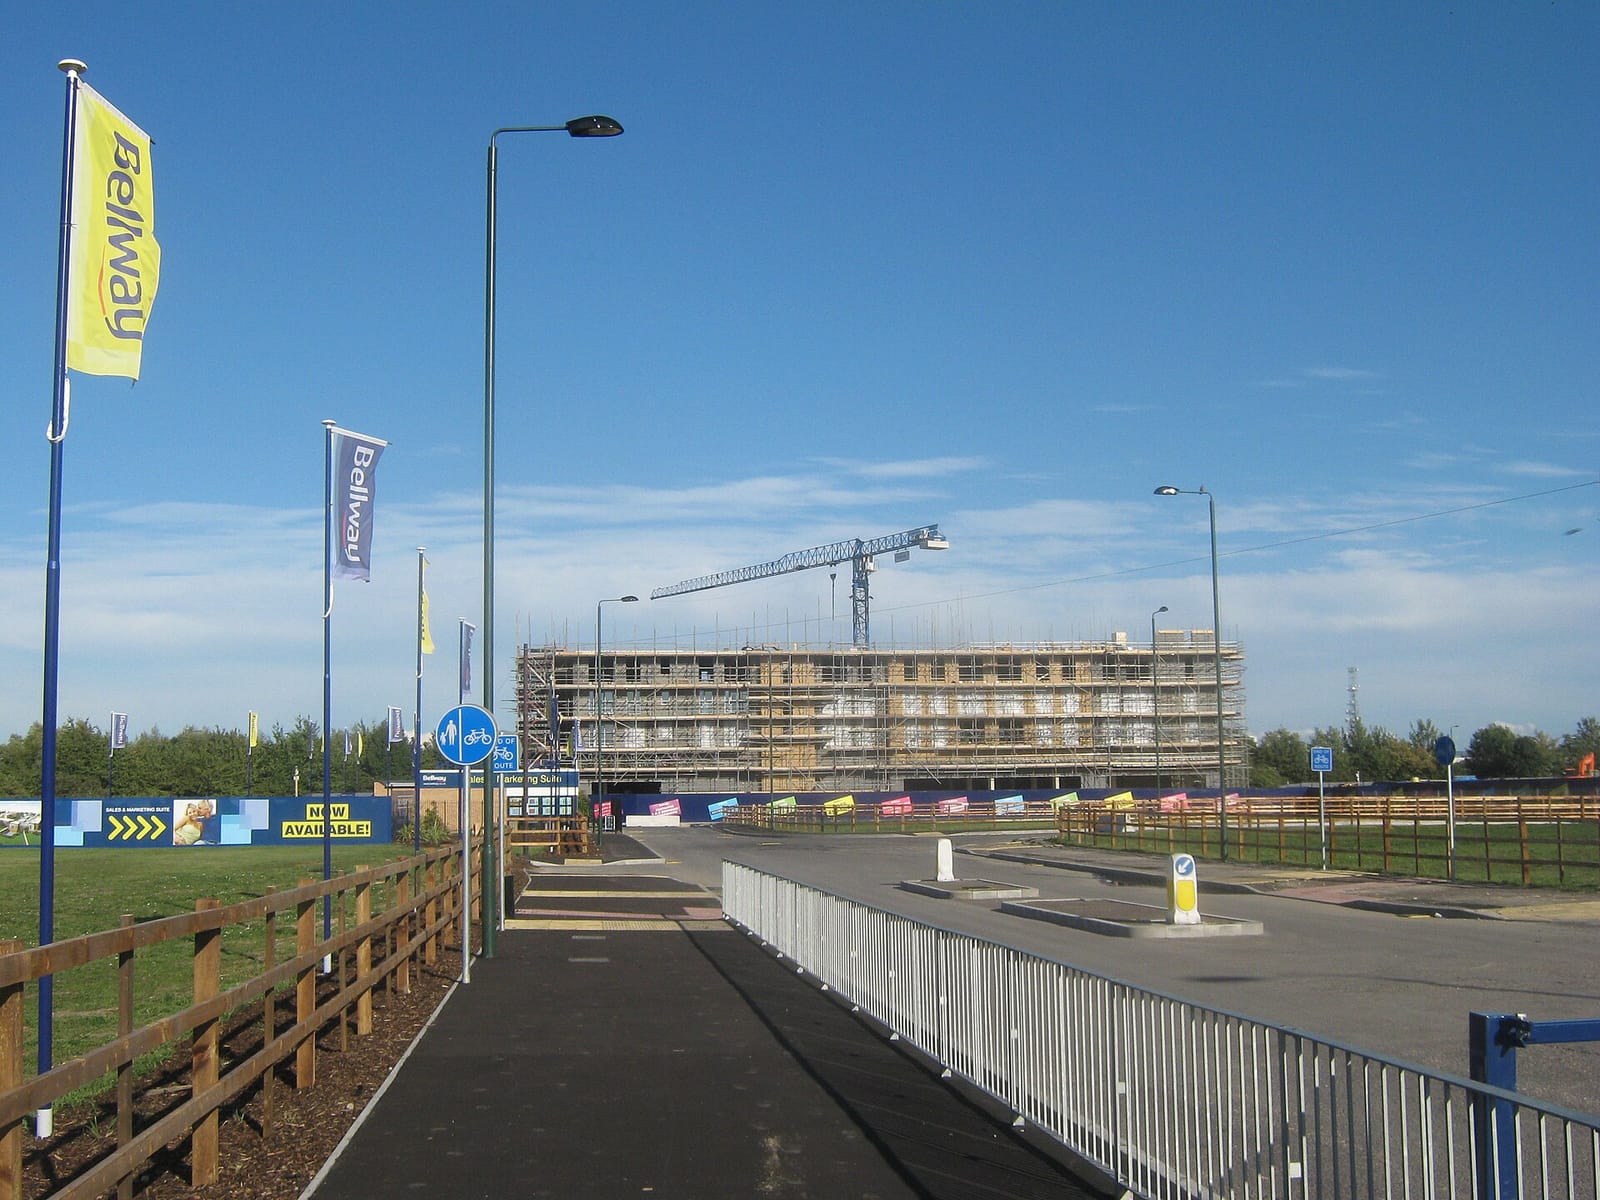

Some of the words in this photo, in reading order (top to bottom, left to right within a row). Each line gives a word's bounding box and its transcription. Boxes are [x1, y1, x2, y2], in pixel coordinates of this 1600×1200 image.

[105, 130, 144, 341] Bellway
[344, 445, 375, 562] Bellway
[469, 775, 485, 784] ales
[284, 824, 369, 836] AVAILABLE!
